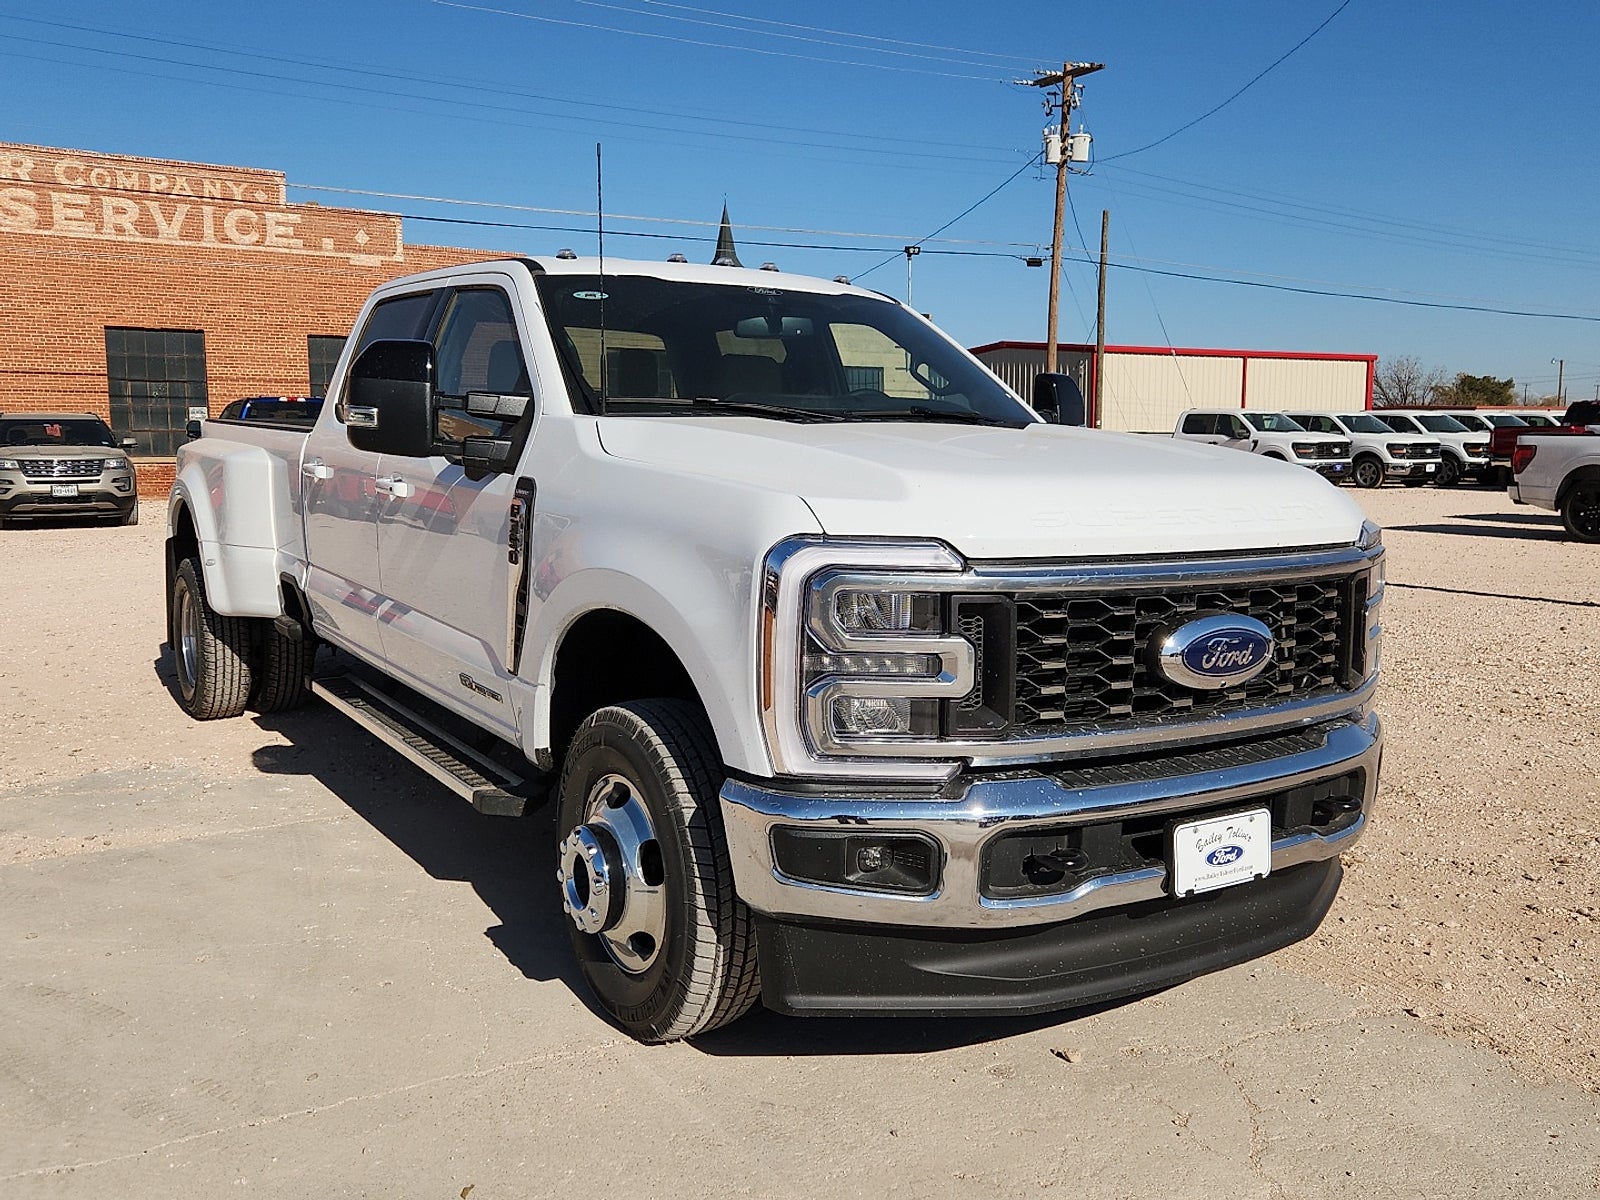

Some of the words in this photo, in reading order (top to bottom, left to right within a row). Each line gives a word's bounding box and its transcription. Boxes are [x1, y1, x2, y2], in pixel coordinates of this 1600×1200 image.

[54, 157, 255, 204] COMPANY
[0, 188, 304, 249] SERVICE
[1202, 636, 1255, 669] Ford
[1212, 846, 1238, 865] Ford
